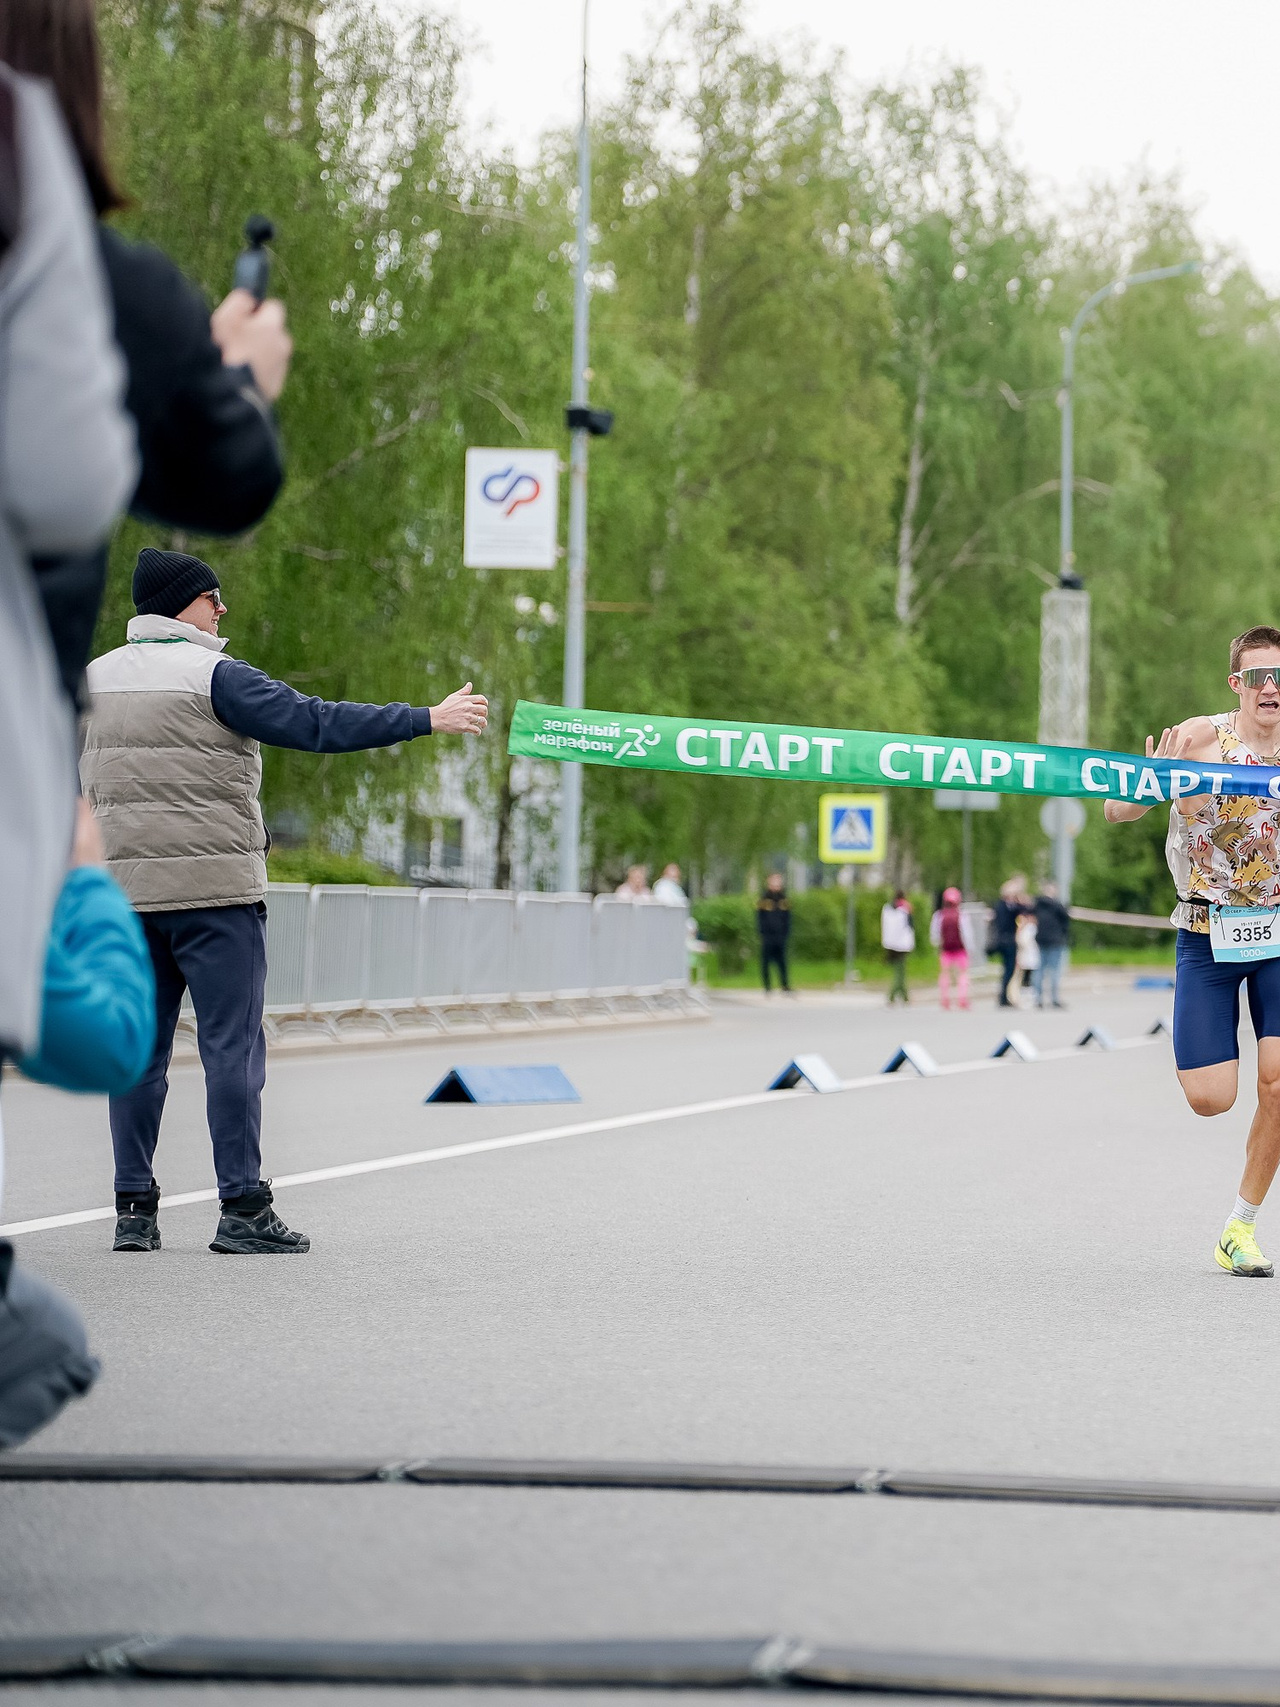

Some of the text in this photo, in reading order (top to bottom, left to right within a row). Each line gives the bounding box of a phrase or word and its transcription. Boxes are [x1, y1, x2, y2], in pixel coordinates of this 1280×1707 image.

[542, 718, 622, 738] зелёный
[533, 732, 614, 753] марафон
[675, 727, 845, 775] СТАРТ
[878, 740, 1047, 789] СТАРТ
[1081, 757, 1233, 802] СТАРТ
[1232, 925, 1272, 943] 3355
